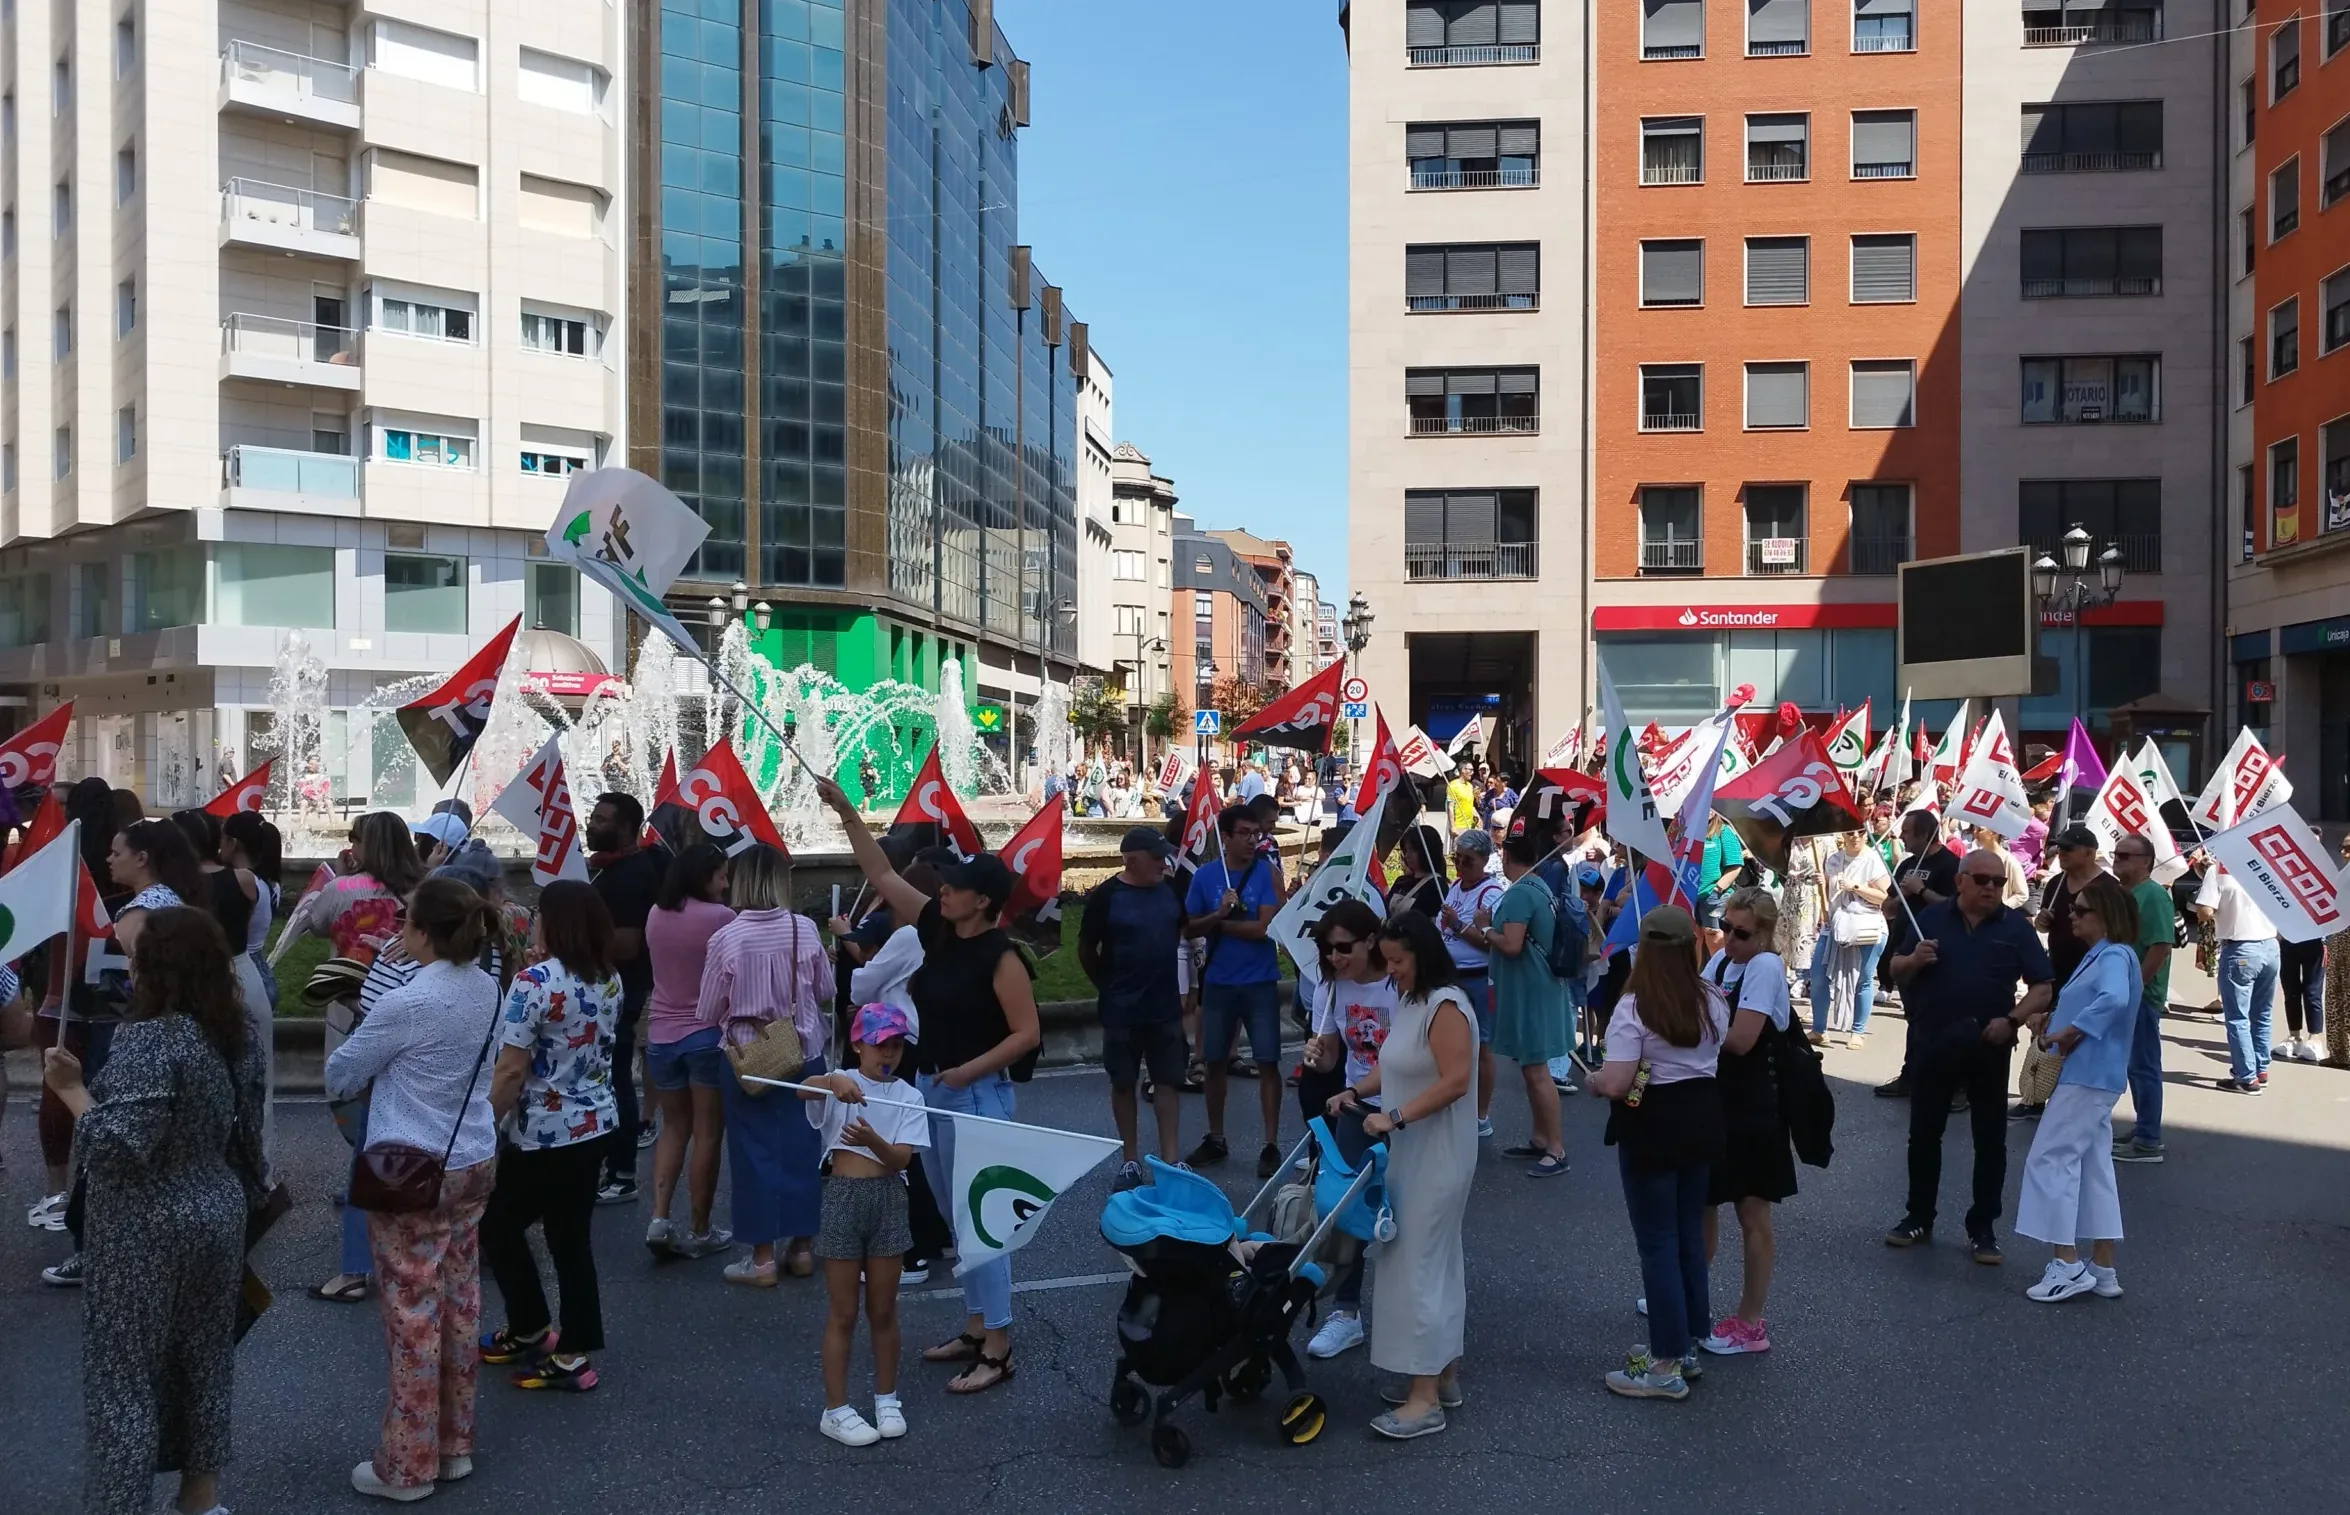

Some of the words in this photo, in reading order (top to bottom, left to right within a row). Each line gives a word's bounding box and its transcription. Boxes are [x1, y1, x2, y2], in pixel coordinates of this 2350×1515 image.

[1700, 611, 1779, 625] Santander
[2327, 628, 2349, 642] Unicaja
[1350, 686, 1362, 695] 20
[2246, 858, 2260, 874] El
[2257, 872, 2291, 910] Bierzo
